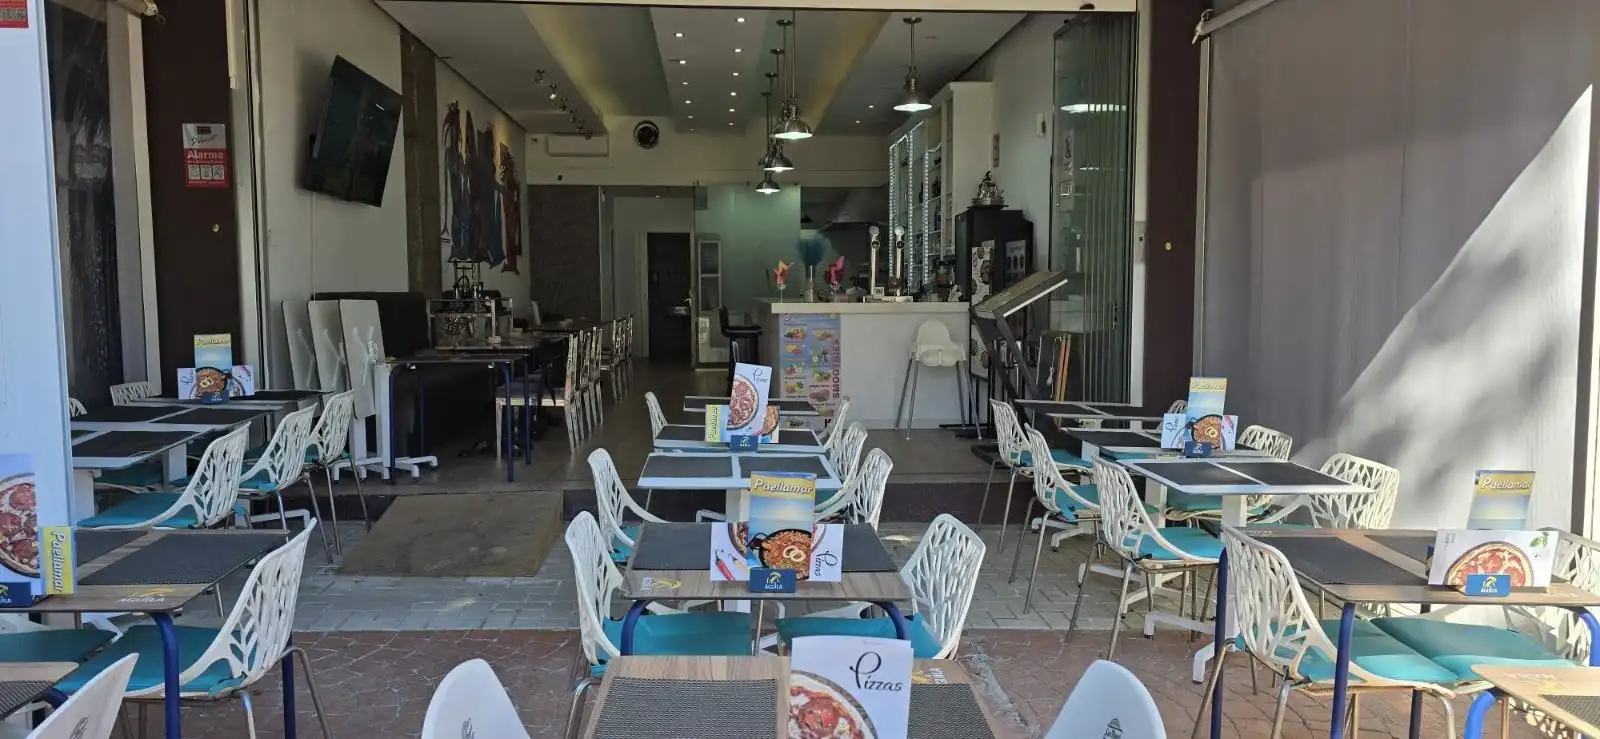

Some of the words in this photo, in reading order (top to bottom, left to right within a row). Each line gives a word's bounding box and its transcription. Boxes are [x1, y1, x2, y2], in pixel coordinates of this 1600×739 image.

[187, 150, 224, 159] Alarma
[832, 339, 840, 399] SMOOTHIES
[754, 478, 814, 494] Paellamar
[50, 531, 65, 593] Paellamar
[849, 650, 904, 692] Pizzas
